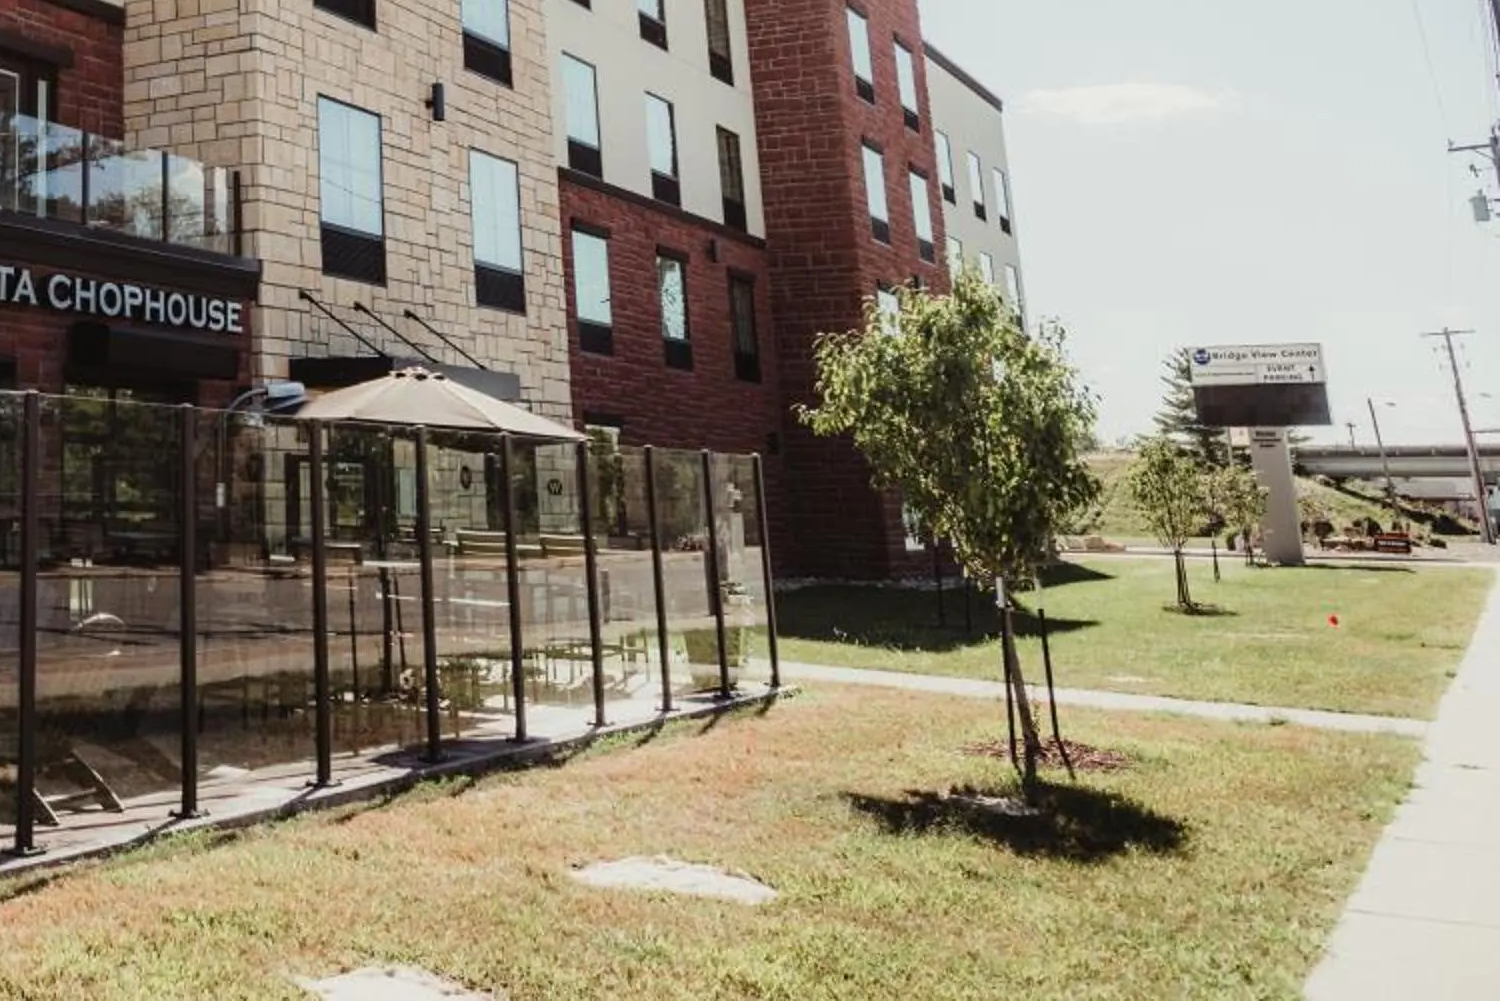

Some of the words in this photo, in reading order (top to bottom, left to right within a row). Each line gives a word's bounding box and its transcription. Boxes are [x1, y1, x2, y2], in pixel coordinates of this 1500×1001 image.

[48, 274, 243, 334] CHOPHOUSE
[1211, 350, 1248, 362] Bridge
[1251, 350, 1277, 360] View
[1280, 349, 1318, 358] Center
